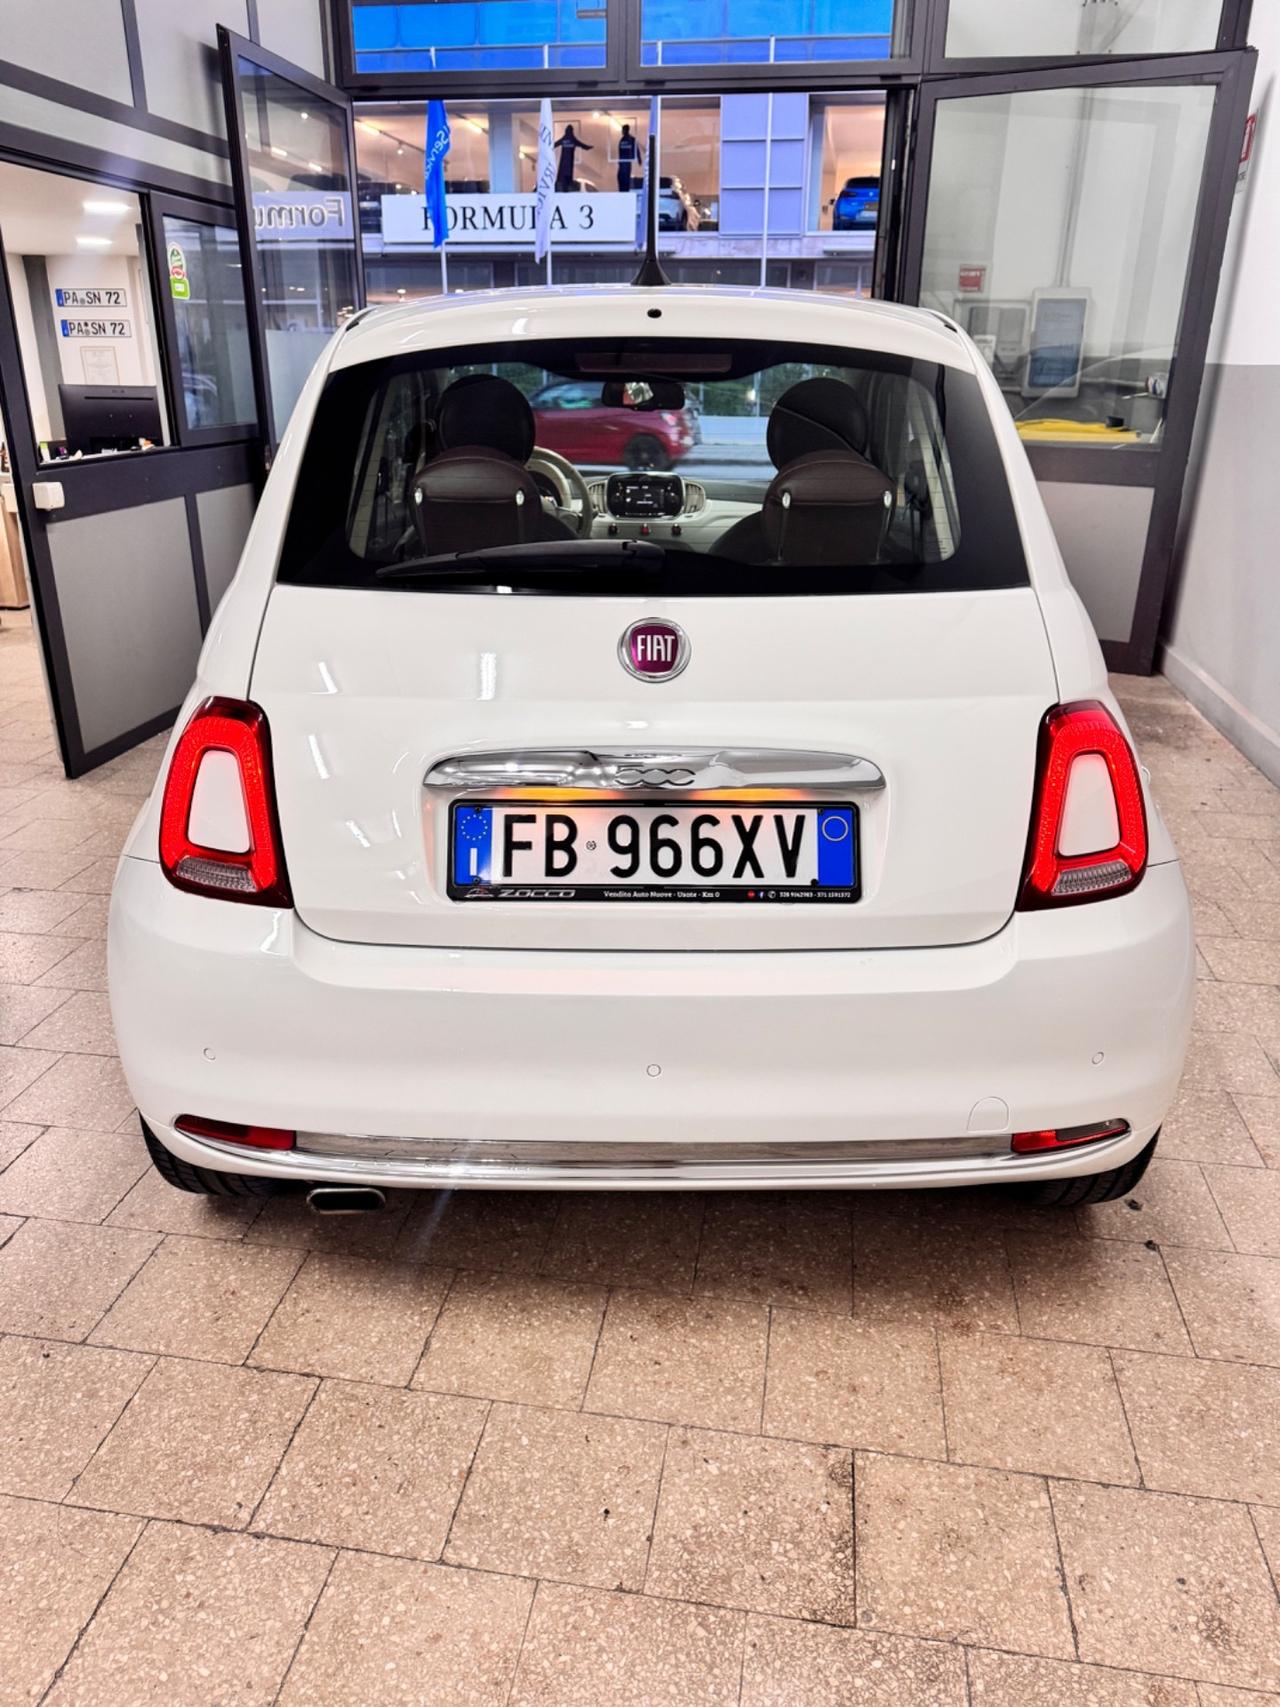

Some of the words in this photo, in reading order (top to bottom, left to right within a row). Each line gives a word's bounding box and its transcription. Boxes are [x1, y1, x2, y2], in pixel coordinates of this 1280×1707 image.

[579, 204, 594, 230] 3
[64, 291, 79, 304] PA
[85, 291, 101, 304] SN
[105, 291, 121, 304] 72
[68, 321, 84, 335] PA
[90, 321, 106, 335] SN
[110, 322, 125, 335] 72
[637, 635, 675, 661] FIAT
[503, 814, 578, 877] FB
[606, 814, 806, 878] 966XV
[498, 889, 576, 898] ZOCCO
